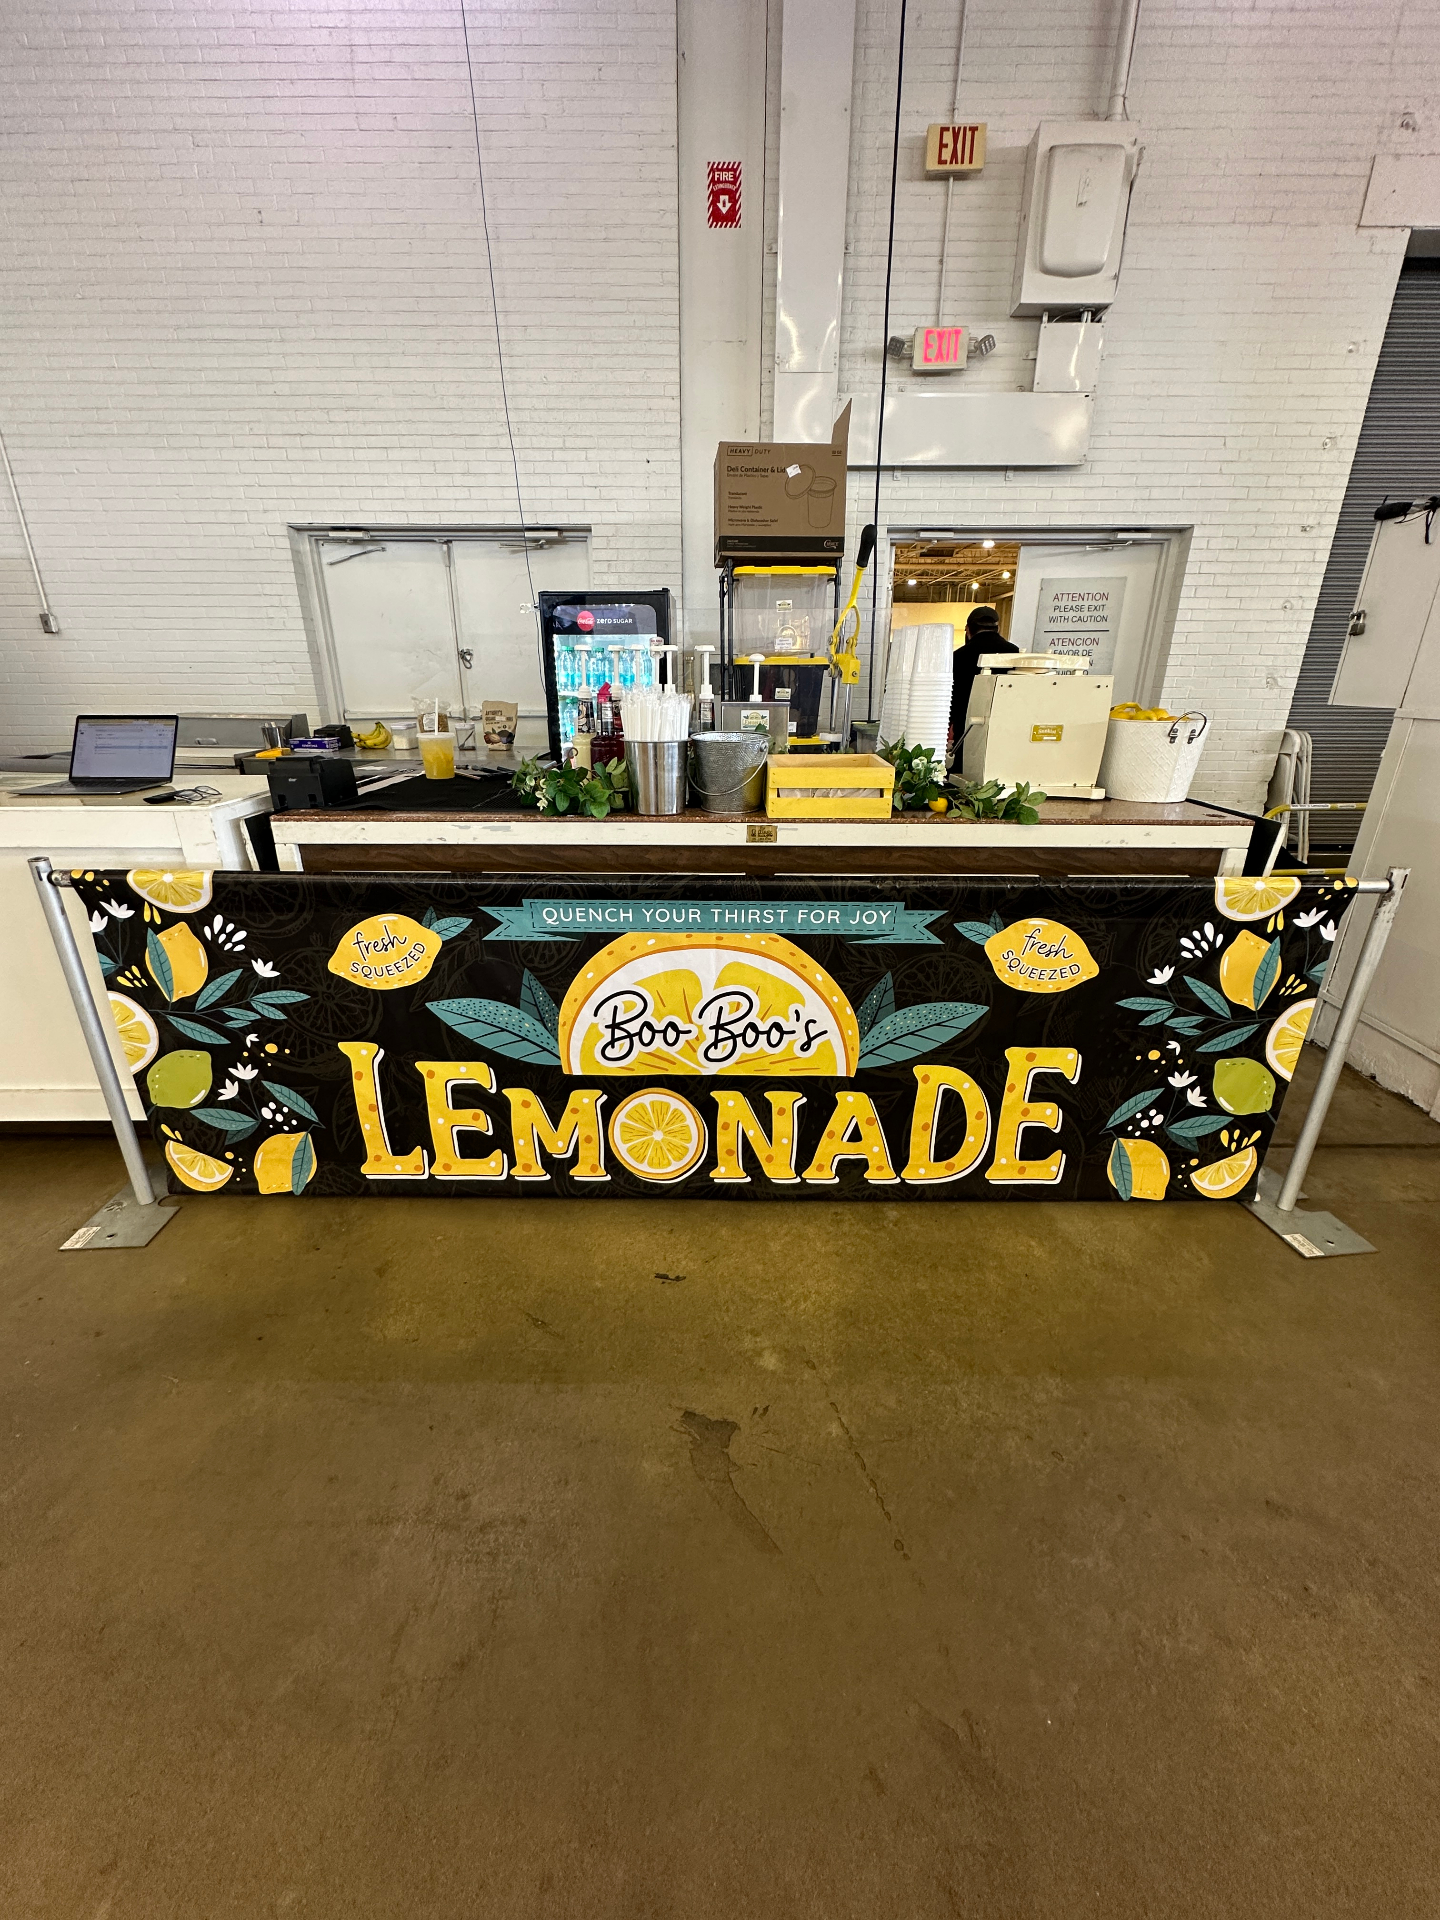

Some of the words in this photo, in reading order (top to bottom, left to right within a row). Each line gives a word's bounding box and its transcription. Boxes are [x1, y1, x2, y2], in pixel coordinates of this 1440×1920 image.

[937, 126, 979, 165] EXIT
[714, 171, 735, 181] FIRE
[922, 328, 963, 363] EXIT
[726, 465, 739, 473] Deli
[1053, 592, 1109, 602] ATTENTION
[1054, 604, 1085, 613] PLEASE
[1087, 604, 1106, 612] EXIT
[1071, 615, 1108, 623] CAUTION
[1049, 637, 1100, 646] ATENCION
[542, 907, 633, 925] QUENCH
[643, 908, 702, 923] YOUR
[710, 909, 789, 924] THIRST
[797, 909, 841, 924] FOR
[849, 910, 893, 925] JOY
[352, 924, 408, 962] fresh
[1021, 927, 1074, 959] fresh
[350, 942, 426, 979] SQUEEZED
[1002, 949, 1081, 980] SQUEEZED
[593, 989, 692, 1062] Boo
[697, 990, 828, 1063] Boo's
[337, 1041, 1083, 1184] LEMONADE
